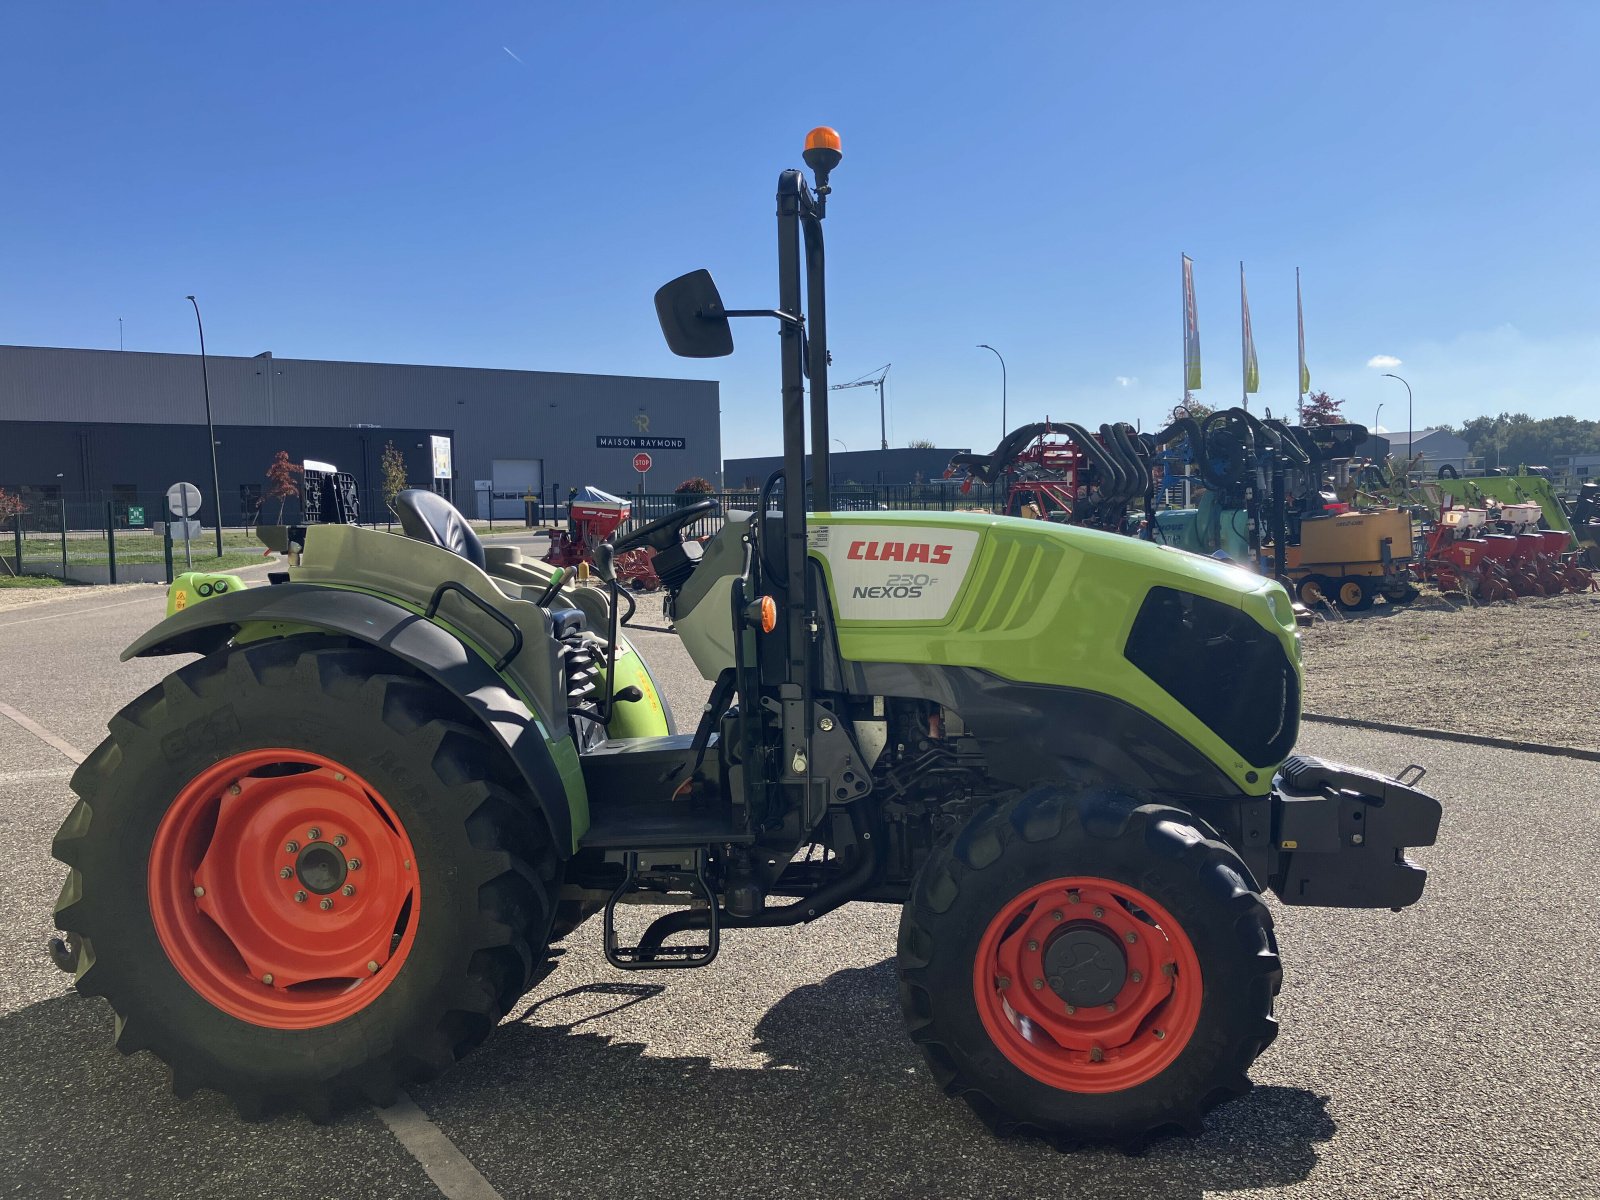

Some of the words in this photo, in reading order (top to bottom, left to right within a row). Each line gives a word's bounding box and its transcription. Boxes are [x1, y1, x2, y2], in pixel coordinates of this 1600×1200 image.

[600, 438, 636, 447] MAISON
[640, 439, 683, 448] RAYMOND
[847, 541, 953, 565] CLAAS
[852, 586, 923, 599] NEXOS
